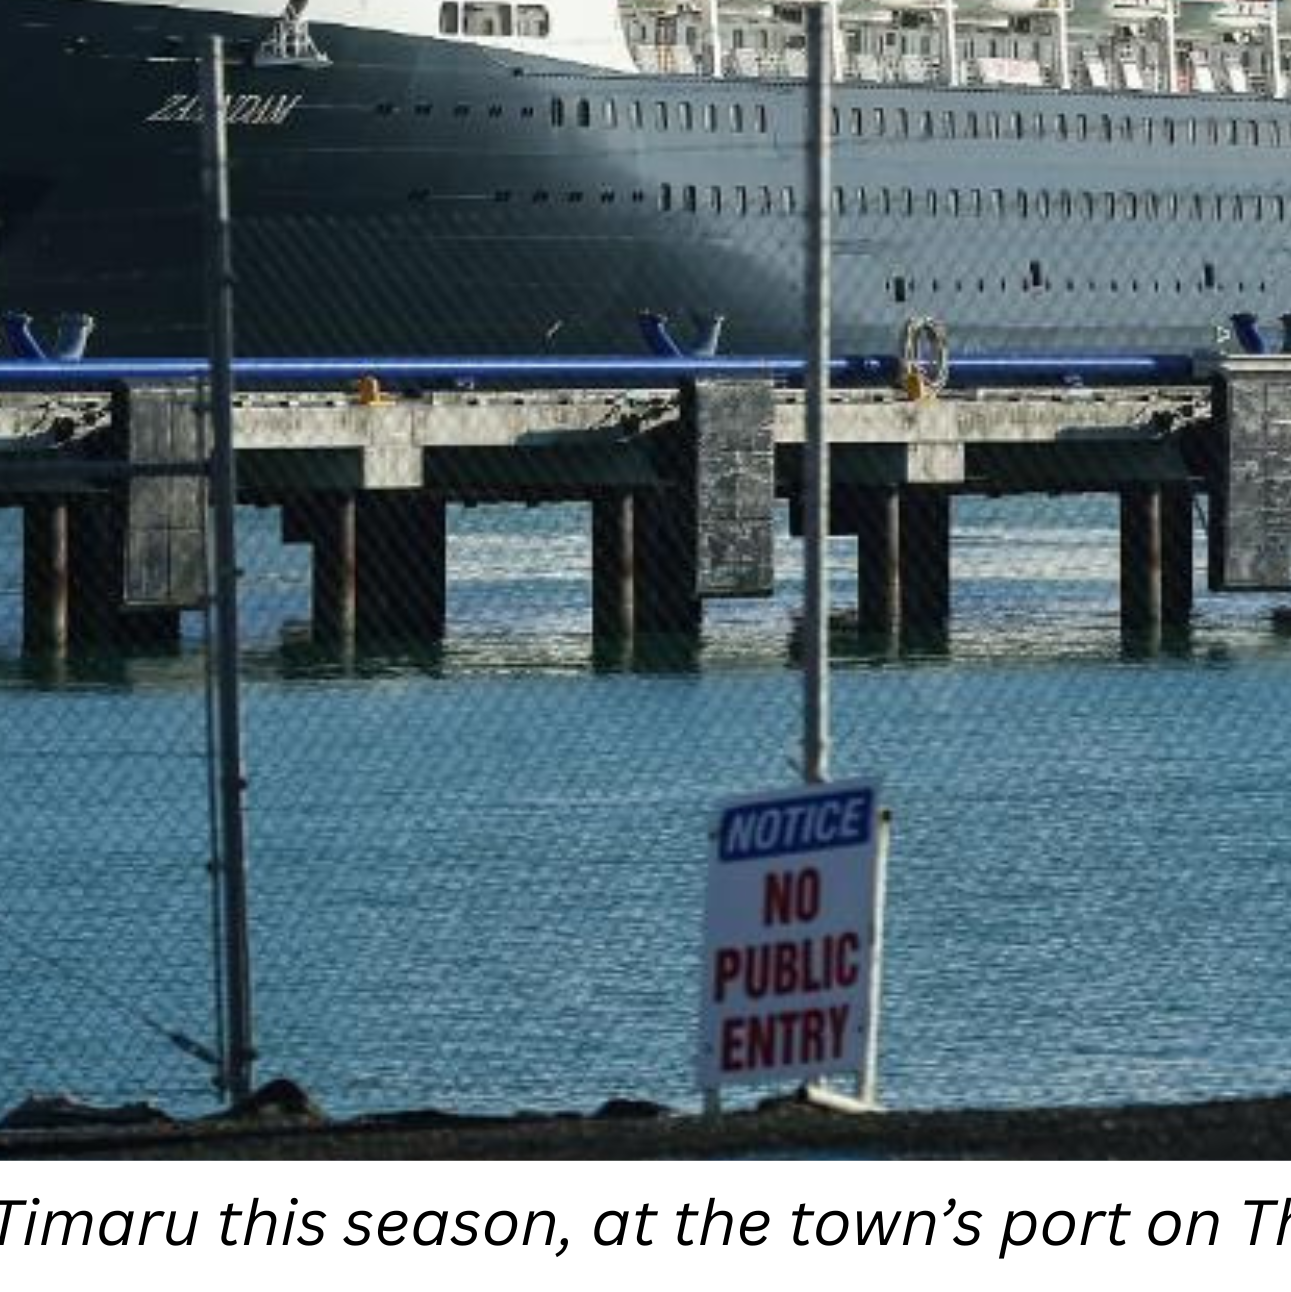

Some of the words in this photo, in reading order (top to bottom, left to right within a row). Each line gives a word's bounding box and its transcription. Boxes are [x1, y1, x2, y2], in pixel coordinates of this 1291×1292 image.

[726, 797, 865, 854] NOTICE
[763, 866, 821, 927] NO
[714, 931, 859, 1004] PUBLIC
[721, 1004, 850, 1073] ENTRY
